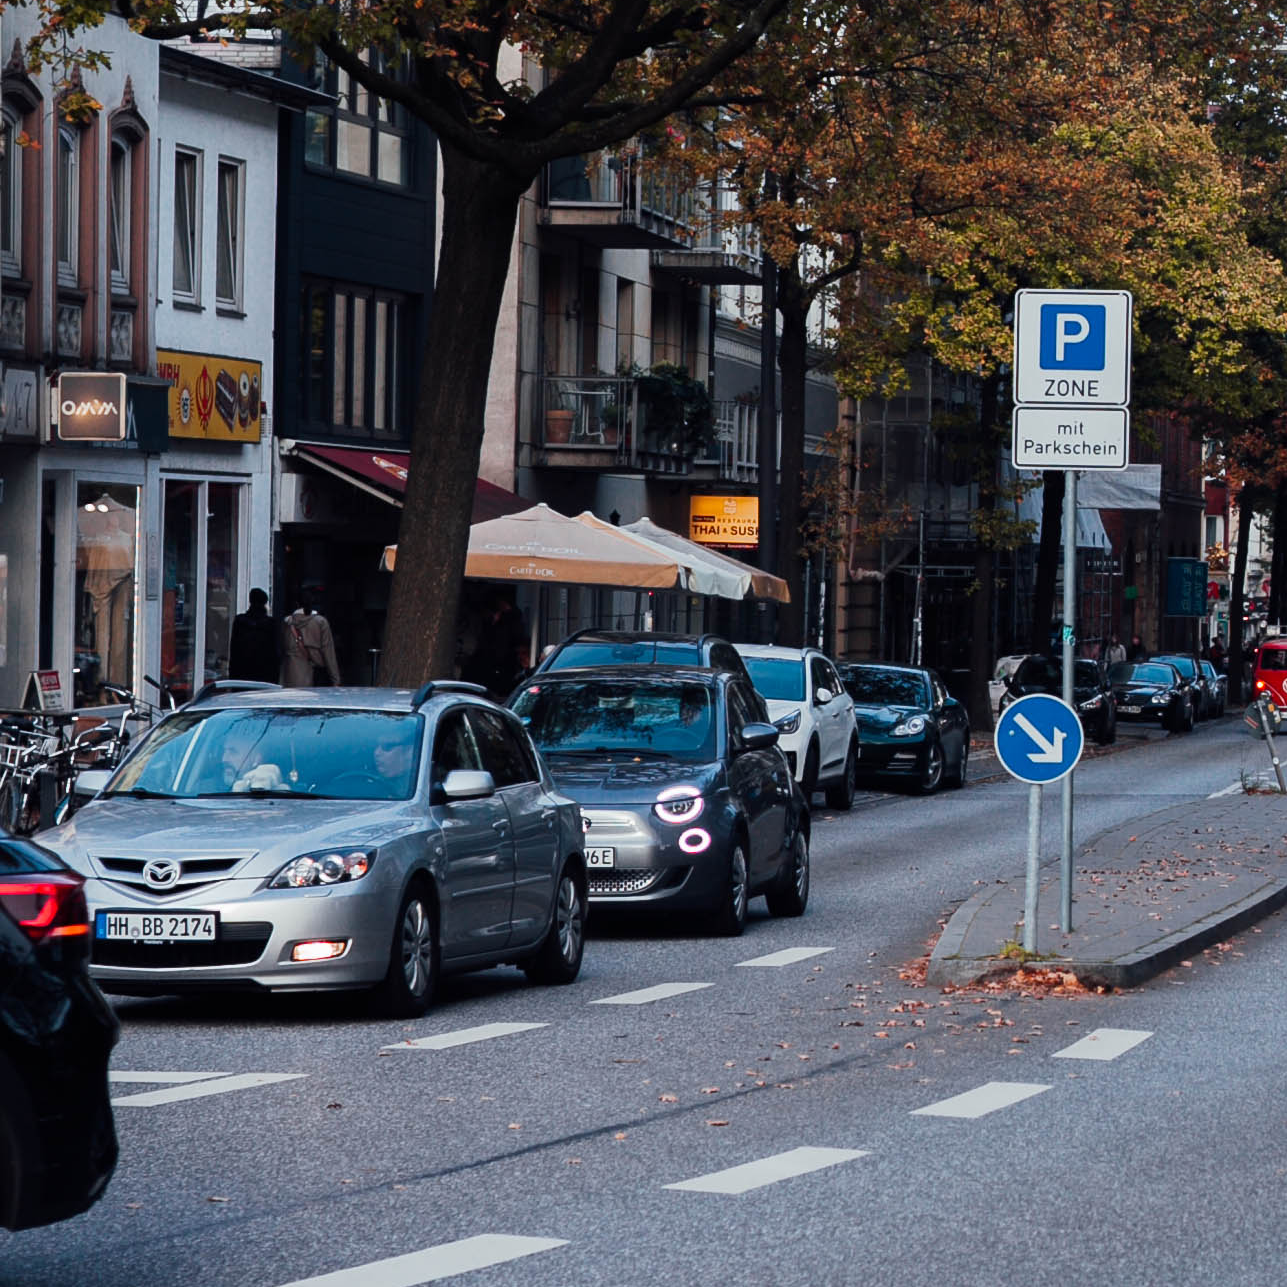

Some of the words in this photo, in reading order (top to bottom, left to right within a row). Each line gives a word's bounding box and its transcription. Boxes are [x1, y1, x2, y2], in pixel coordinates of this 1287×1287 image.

[1056, 313, 1090, 361] P
[1044, 379, 1099, 397] ZONE
[1057, 421, 1084, 435] mit
[1024, 439, 1118, 455] Parkschein
[692, 525, 720, 535] THAI
[107, 917, 129, 936] HH
[142, 917, 164, 936] BB
[168, 917, 212, 937] 2174
